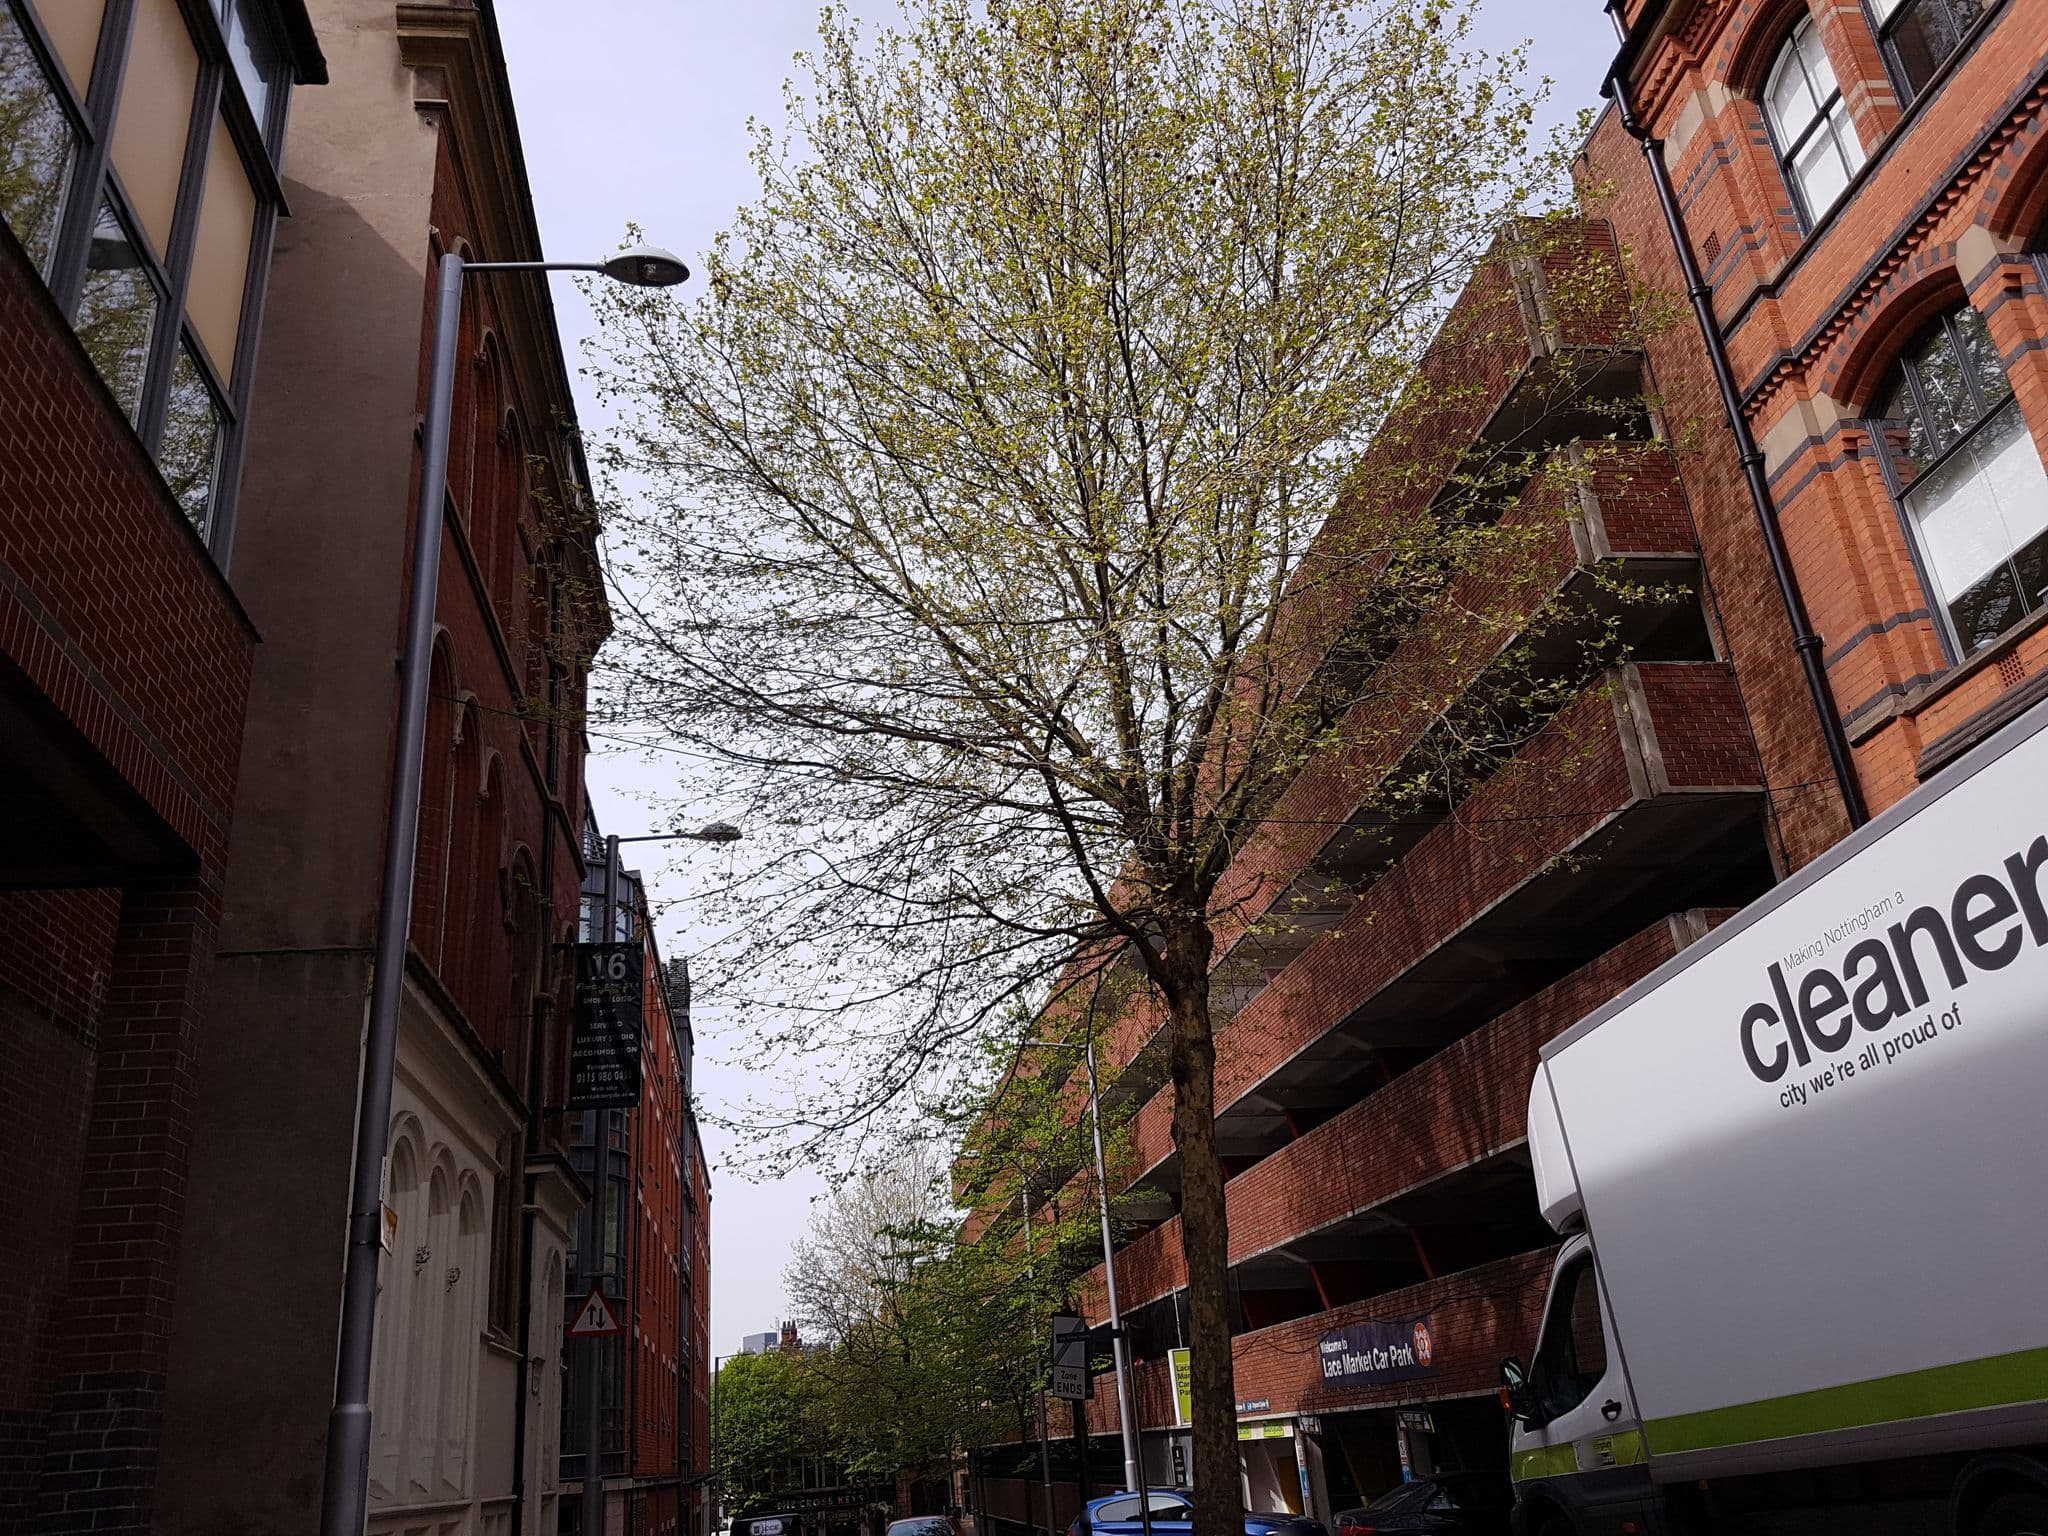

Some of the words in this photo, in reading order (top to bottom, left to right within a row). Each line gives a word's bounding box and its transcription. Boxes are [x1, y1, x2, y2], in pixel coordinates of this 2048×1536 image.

[1783, 937, 1824, 971] Making
[1824, 899, 1893, 947] Nottingham
[1895, 890, 1905, 905] a
[591, 952, 627, 981] 16
[1740, 834, 2048, 1083] cleaner
[1779, 1081, 1808, 1108] city
[1809, 1063, 1855, 1094] we're
[1858, 1042, 1881, 1072] all
[1882, 1013, 1938, 1065] proud
[1941, 1002, 1963, 1031] of
[1320, 1340, 1342, 1354] Welcome
[1341, 1338, 1348, 1350] to
[1322, 1357, 1343, 1378] Lace
[1342, 1350, 1374, 1375] Market
[1373, 1347, 1389, 1370] Car
[1389, 1343, 1414, 1367] Park
[1056, 1382, 1082, 1395] ENDS
[1060, 1370, 1078, 1381] Zone
[799, 1497, 833, 1509] CROSS
[837, 1494, 865, 1505] KEYS
